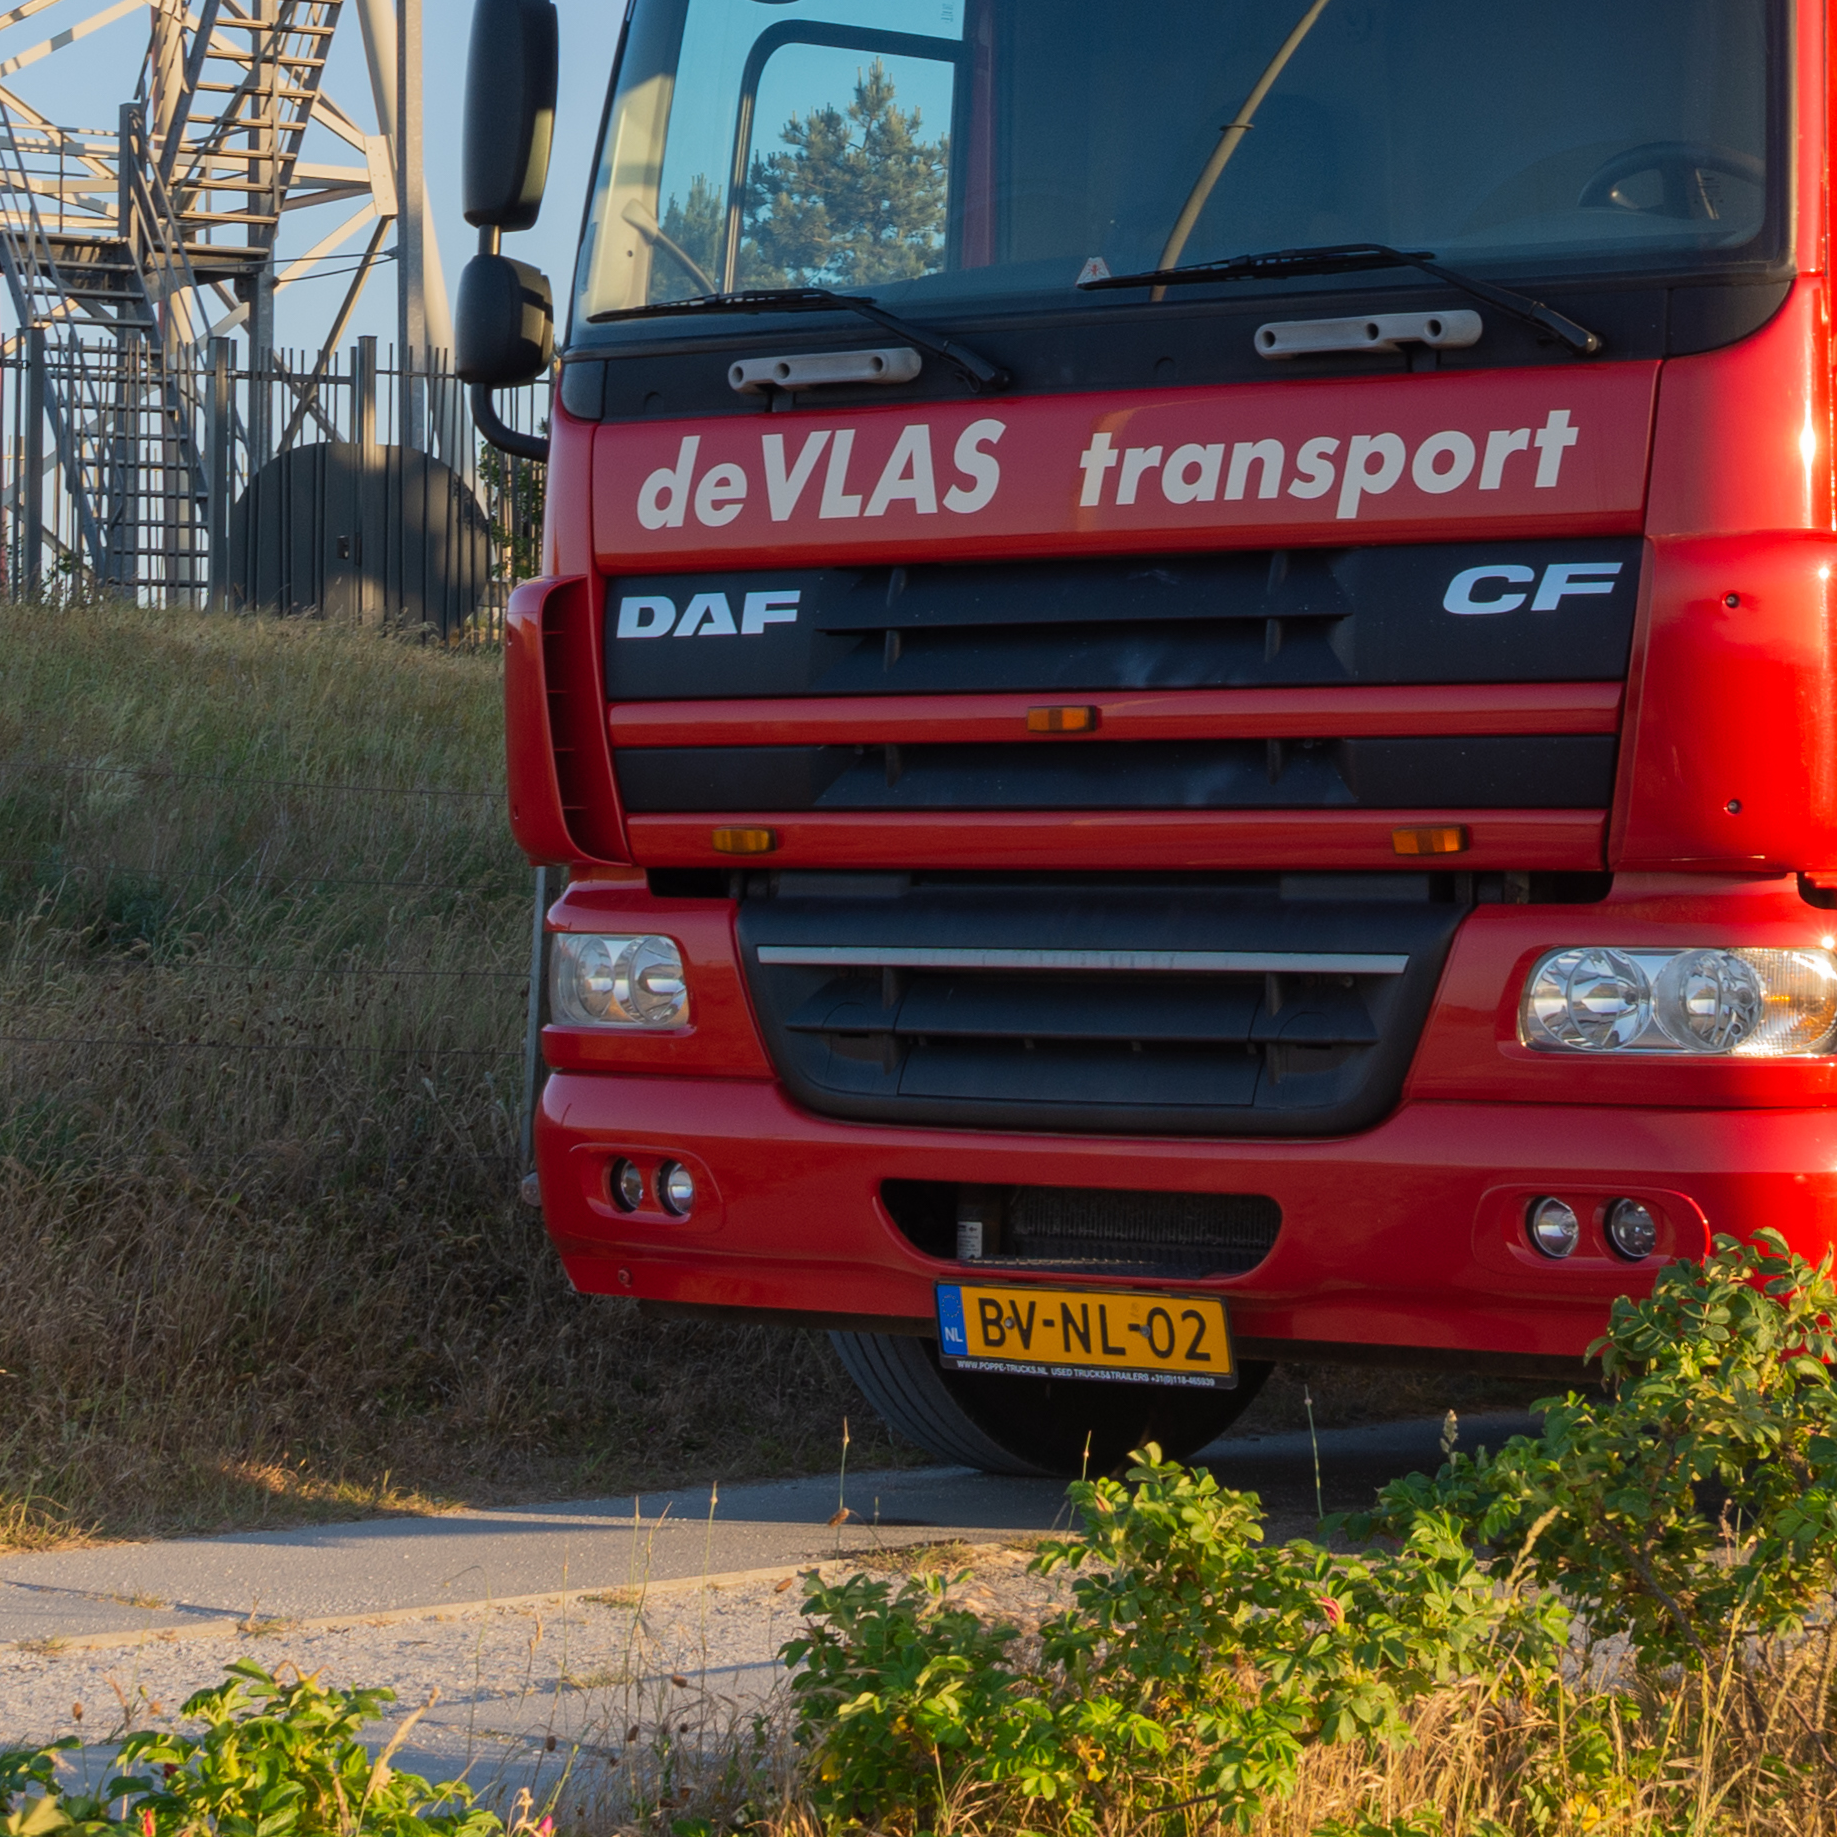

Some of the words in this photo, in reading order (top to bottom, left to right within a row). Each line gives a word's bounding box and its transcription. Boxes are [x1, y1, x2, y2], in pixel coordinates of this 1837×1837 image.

[636, 418, 1007, 531] deVLAS
[1079, 409, 1580, 520] transport
[1443, 562, 1623, 615] CF
[616, 590, 801, 639] DAF
[944, 1326, 963, 1343] NL
[978, 1297, 1211, 1362] BV-NL-02
[1050, 1367, 1073, 1377] USED
